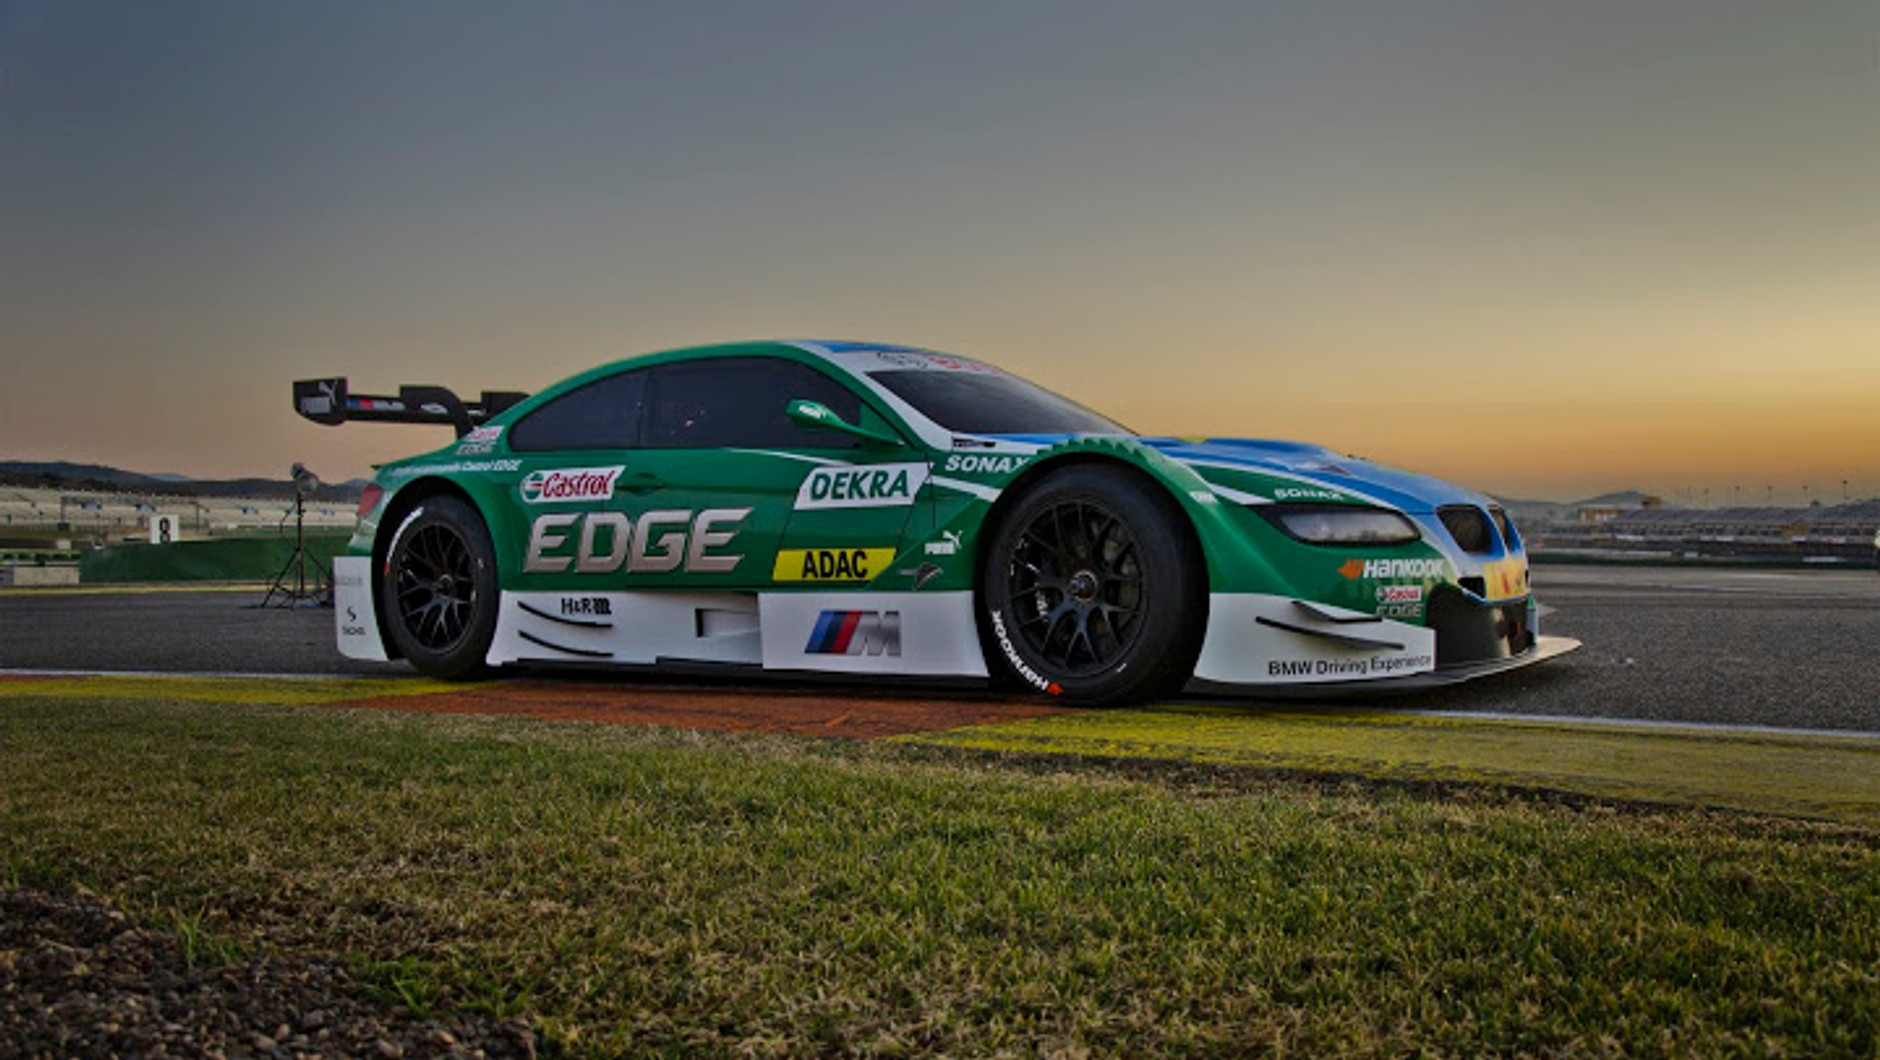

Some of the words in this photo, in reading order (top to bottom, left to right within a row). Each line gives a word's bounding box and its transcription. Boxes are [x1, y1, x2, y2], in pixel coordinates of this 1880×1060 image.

[542, 470, 615, 498] Castrol
[810, 470, 910, 500] DEKRA
[159, 517, 171, 543] 8
[523, 507, 754, 573] EDGE
[802, 550, 868, 579] ADAC
[1268, 660, 1313, 676] BMW
[1316, 657, 1368, 675] Driving
[1370, 654, 1432, 672] Experience
